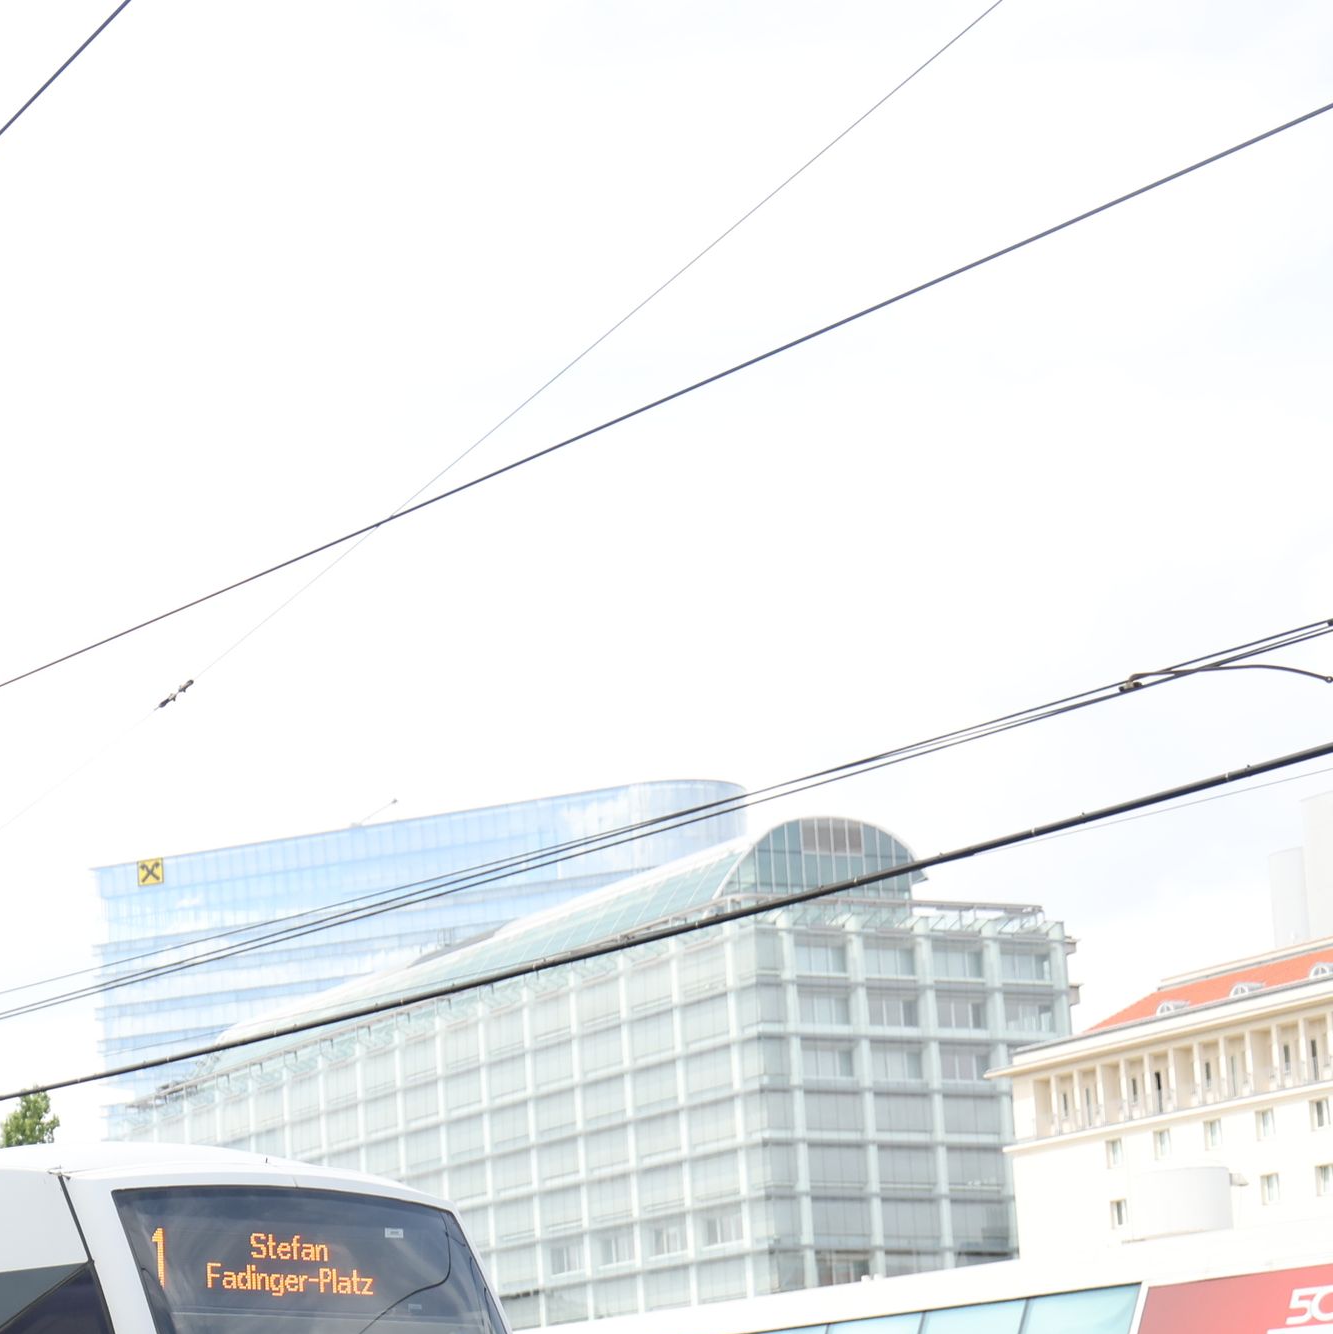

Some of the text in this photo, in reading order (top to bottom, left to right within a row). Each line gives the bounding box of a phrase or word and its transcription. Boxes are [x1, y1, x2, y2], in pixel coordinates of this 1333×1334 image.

[151, 1227, 165, 1290] 1
[250, 1232, 329, 1262] Stefan
[206, 1262, 374, 1297] Fadinger-Platz
